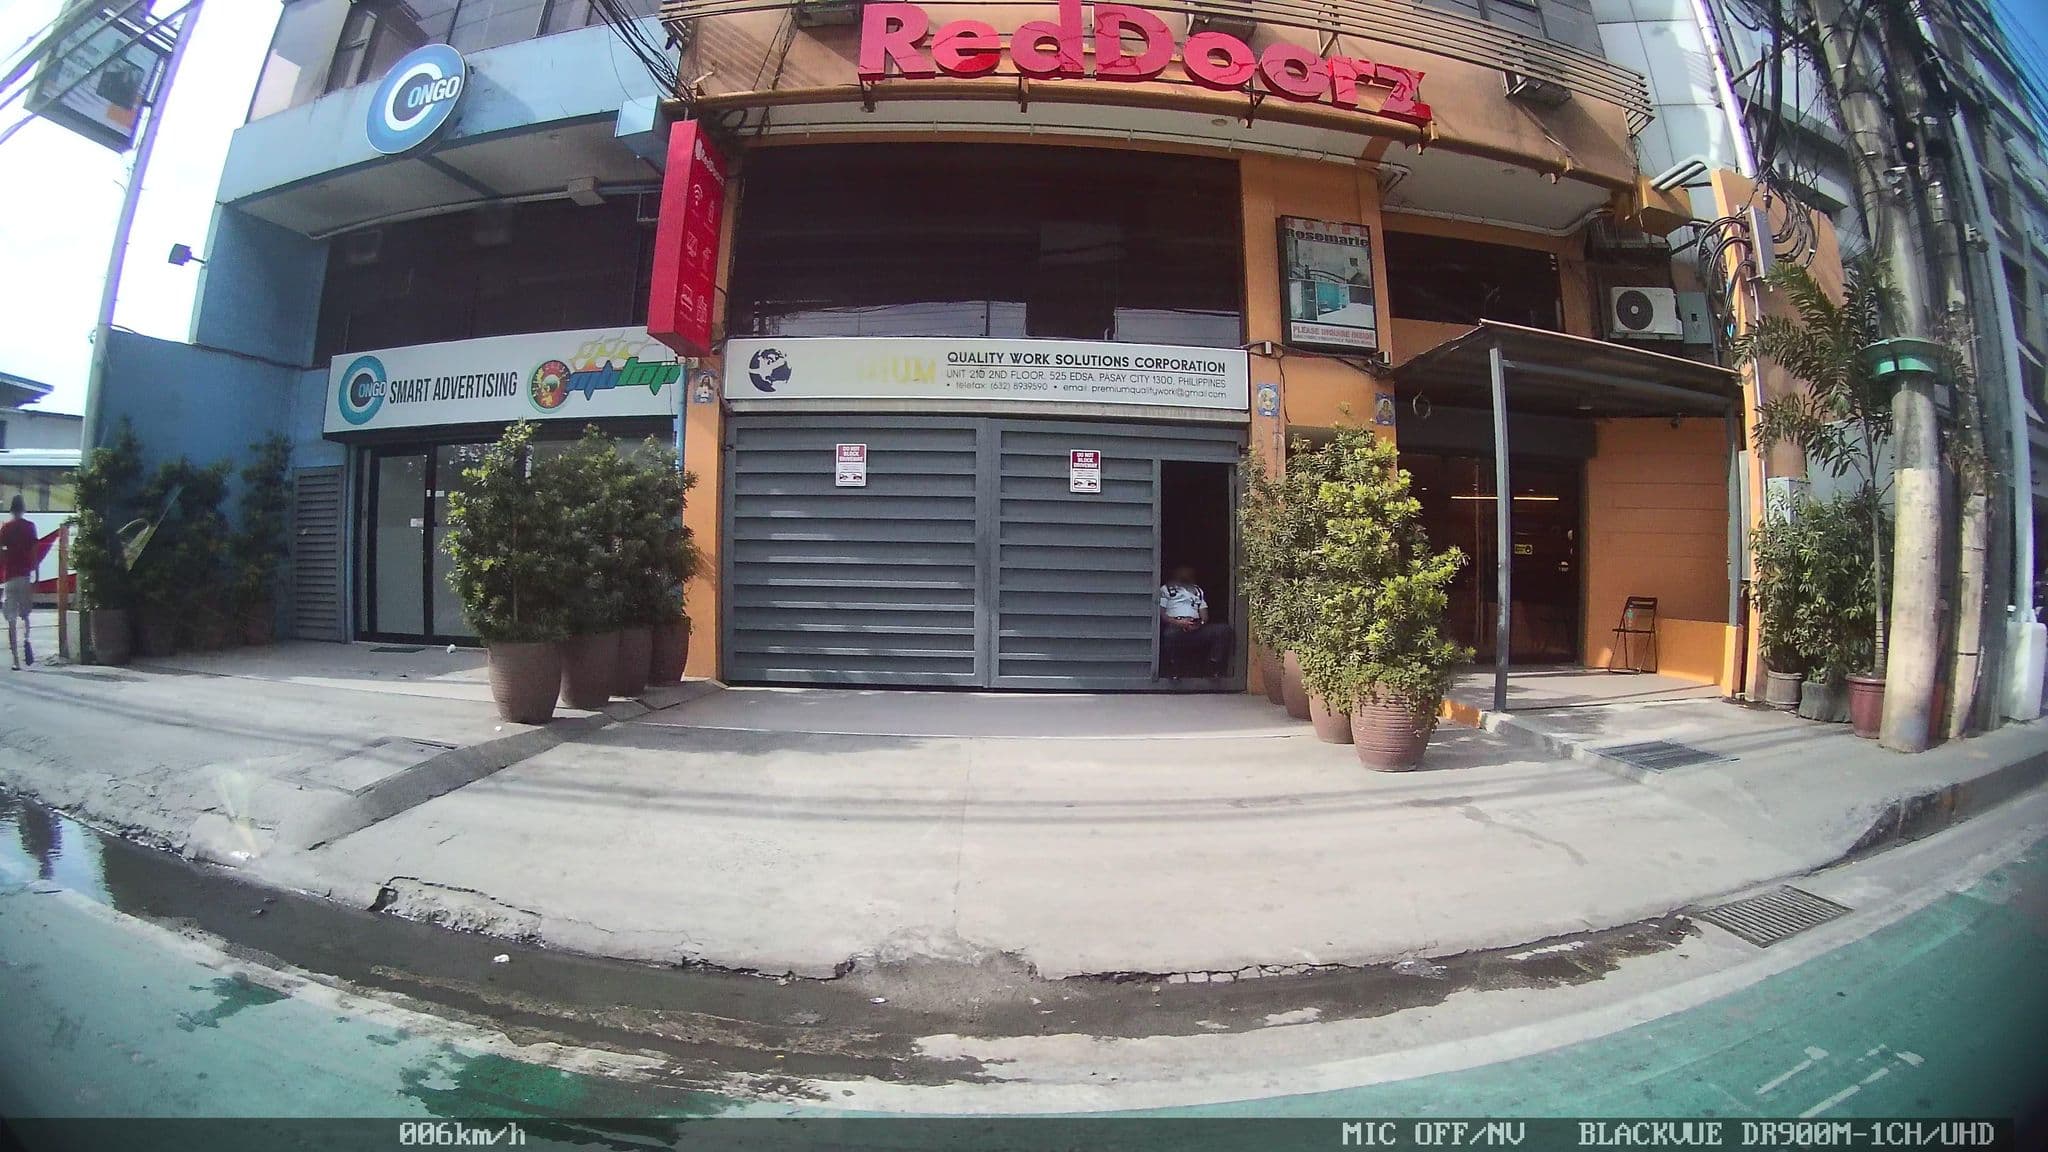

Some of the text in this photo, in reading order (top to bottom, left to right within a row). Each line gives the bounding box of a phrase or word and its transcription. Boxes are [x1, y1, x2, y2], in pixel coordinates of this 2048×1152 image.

[857, 0, 1433, 122] RedDoorz
[947, 351, 1225, 373] QUALITY WORK SOLUTIONS CORPORATION
[389, 371, 518, 404] SMART ADVERTISING
[947, 369, 966, 379] UNIT
[989, 370, 1008, 379] 2ND
[1050, 371, 1066, 381] 525
[1099, 372, 1127, 382] PASAY
[1130, 374, 1150, 383] CITY
[1178, 376, 1226, 388] PHILIPPINES
